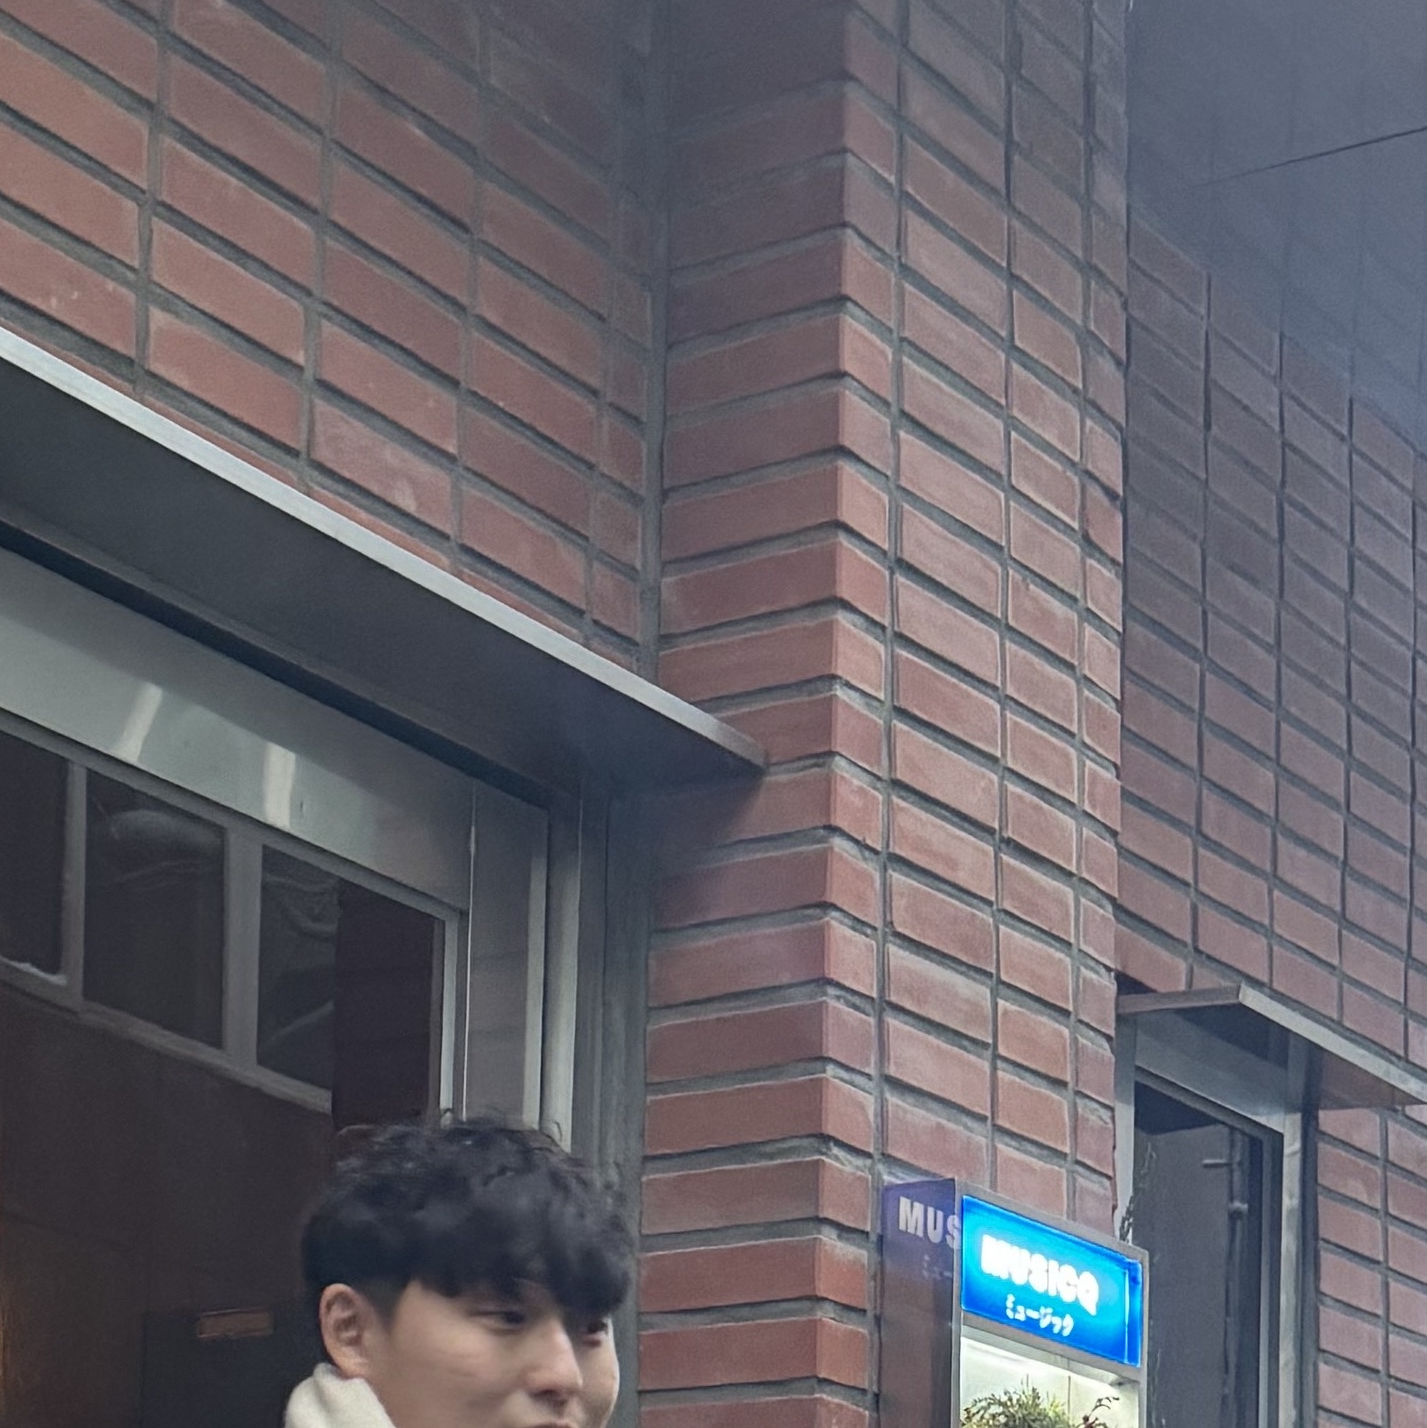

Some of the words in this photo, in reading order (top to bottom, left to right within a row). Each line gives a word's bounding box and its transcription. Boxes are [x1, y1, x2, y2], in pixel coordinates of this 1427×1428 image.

[1006, 1293, 1074, 1337] ミュージック
